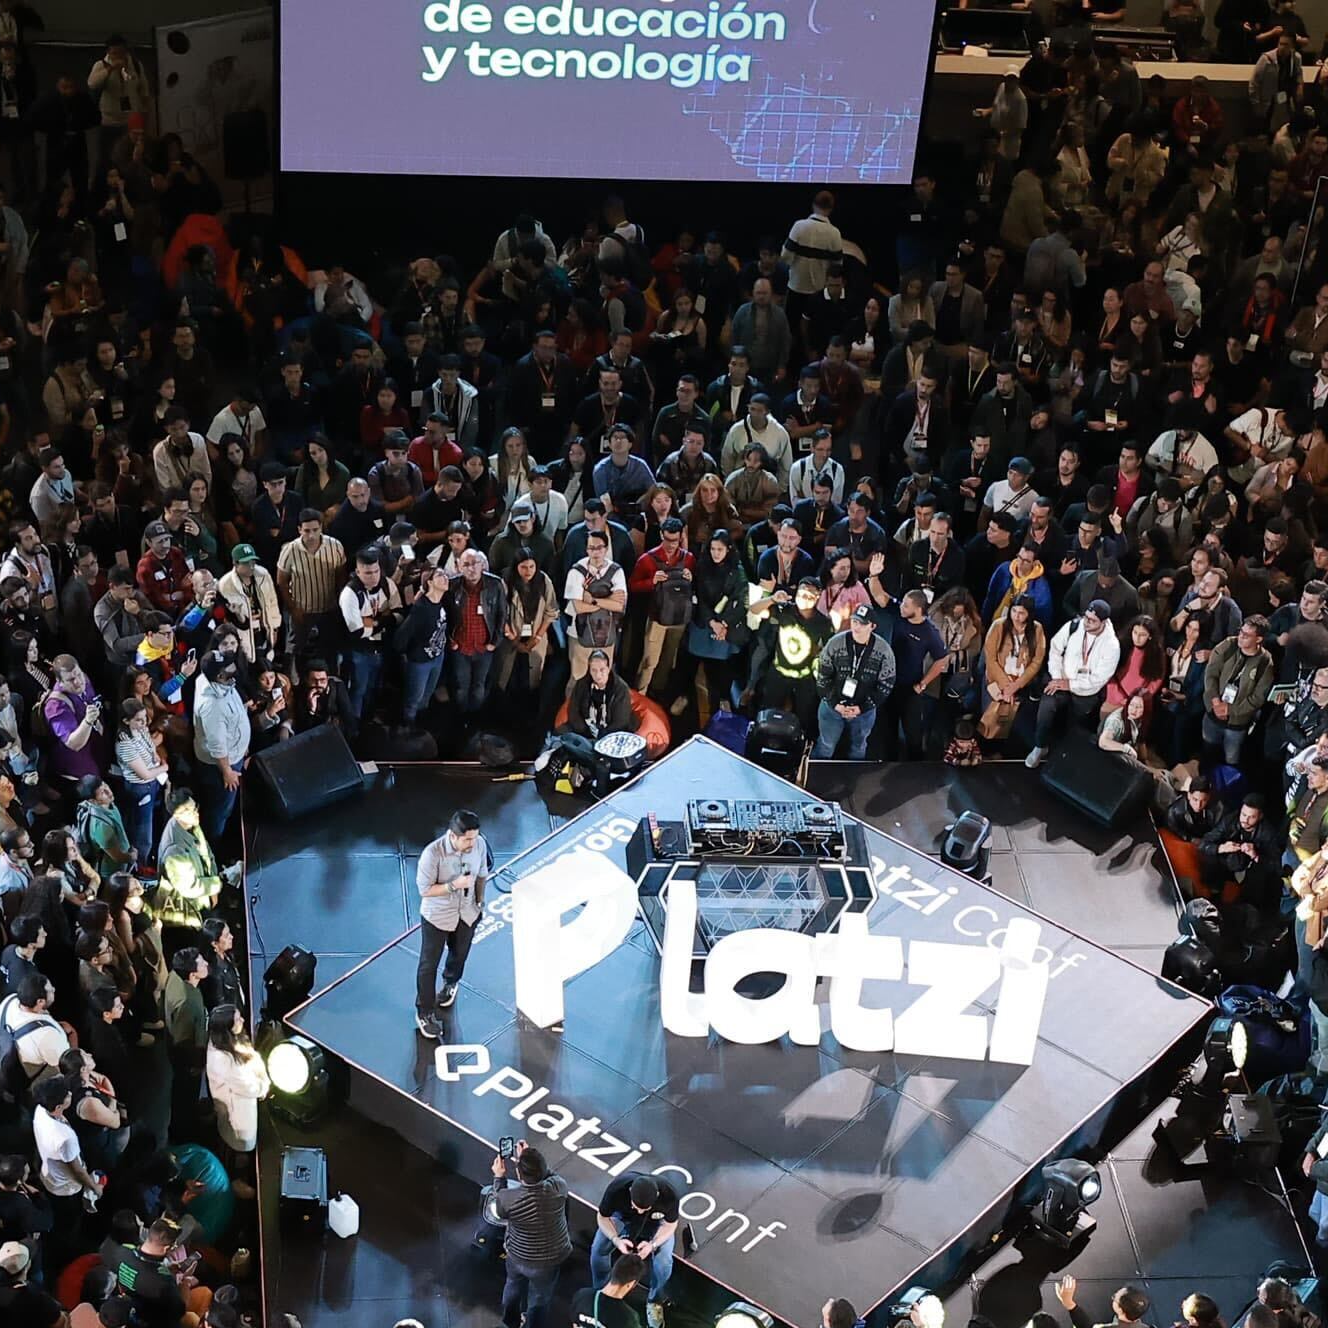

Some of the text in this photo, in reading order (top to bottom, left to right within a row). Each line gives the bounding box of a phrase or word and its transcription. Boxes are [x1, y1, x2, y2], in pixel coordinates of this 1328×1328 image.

[424, 0, 785, 40] de educación
[422, 41, 751, 88] y tecnología
[511, 852, 1049, 1067] Platzi
[472, 1065, 653, 1177] Platzi
